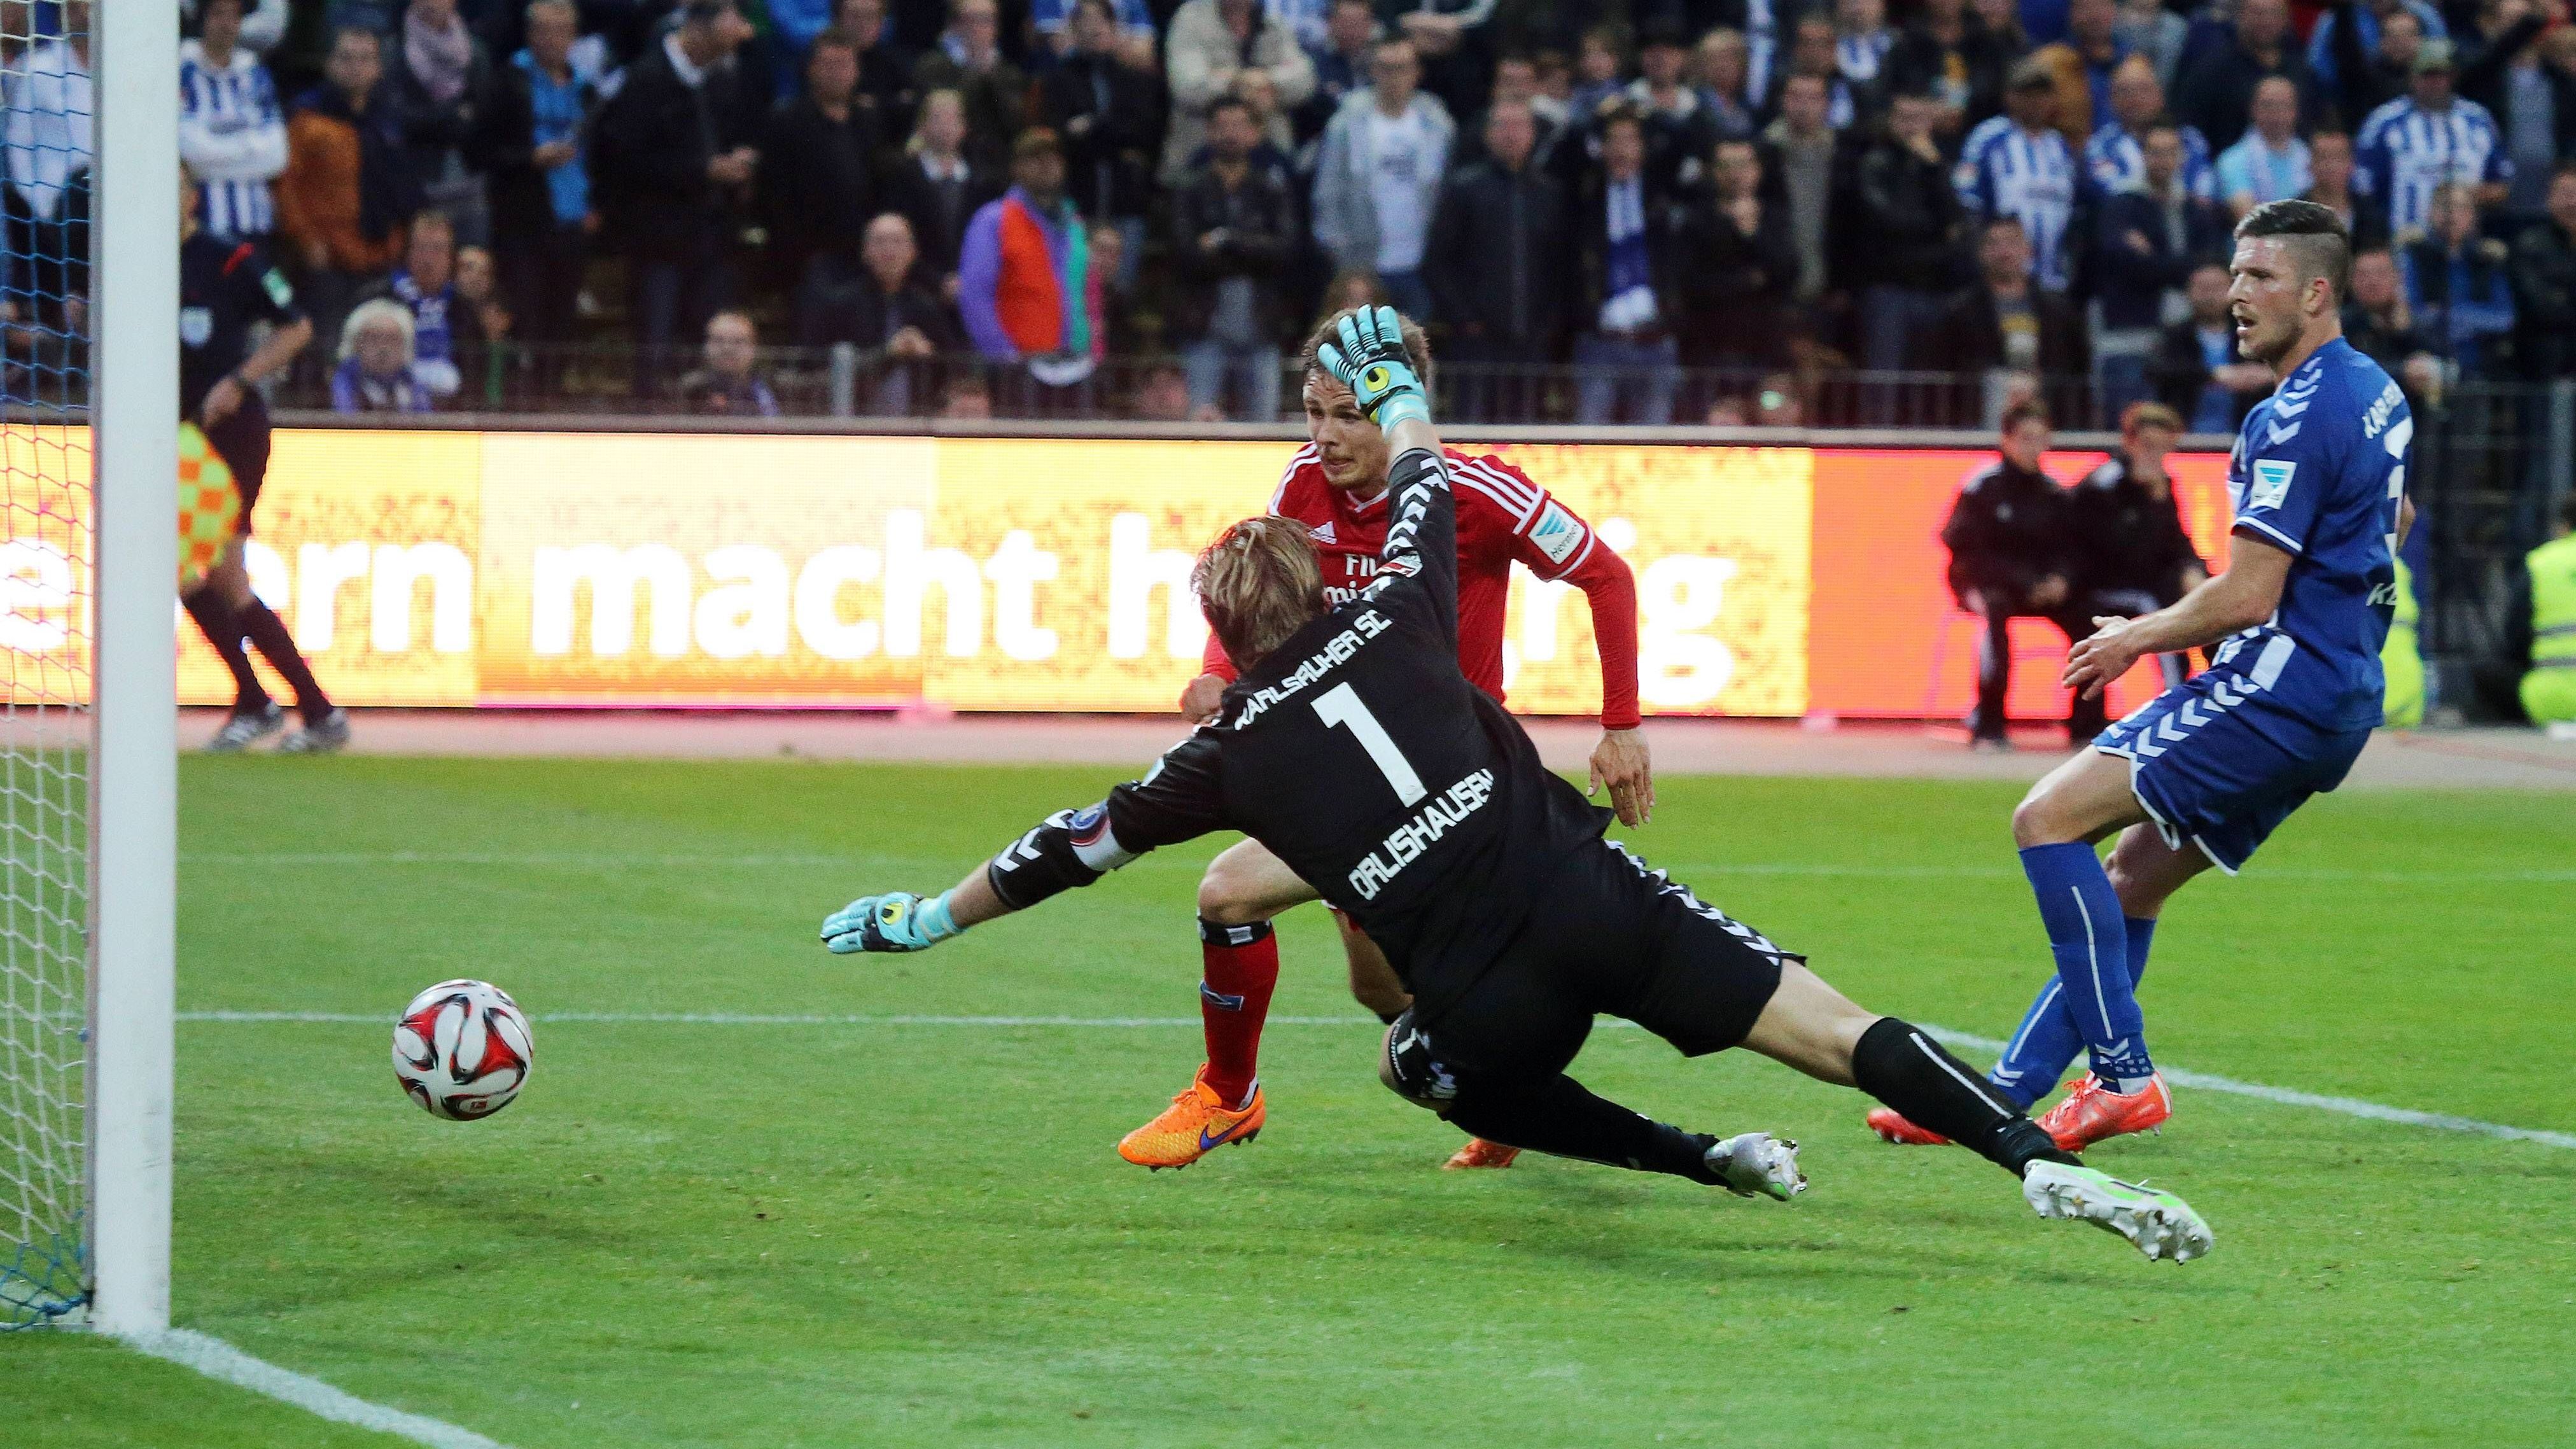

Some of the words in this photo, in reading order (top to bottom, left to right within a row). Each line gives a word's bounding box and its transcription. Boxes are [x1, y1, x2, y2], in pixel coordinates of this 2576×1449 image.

[531, 508, 1060, 661] macht
[1233, 629, 1365, 731] KARLSRUHER
[1353, 609, 1394, 640] SC
[1310, 681, 1428, 808] 1
[1348, 768, 1495, 900] ORLISHAUSEN
